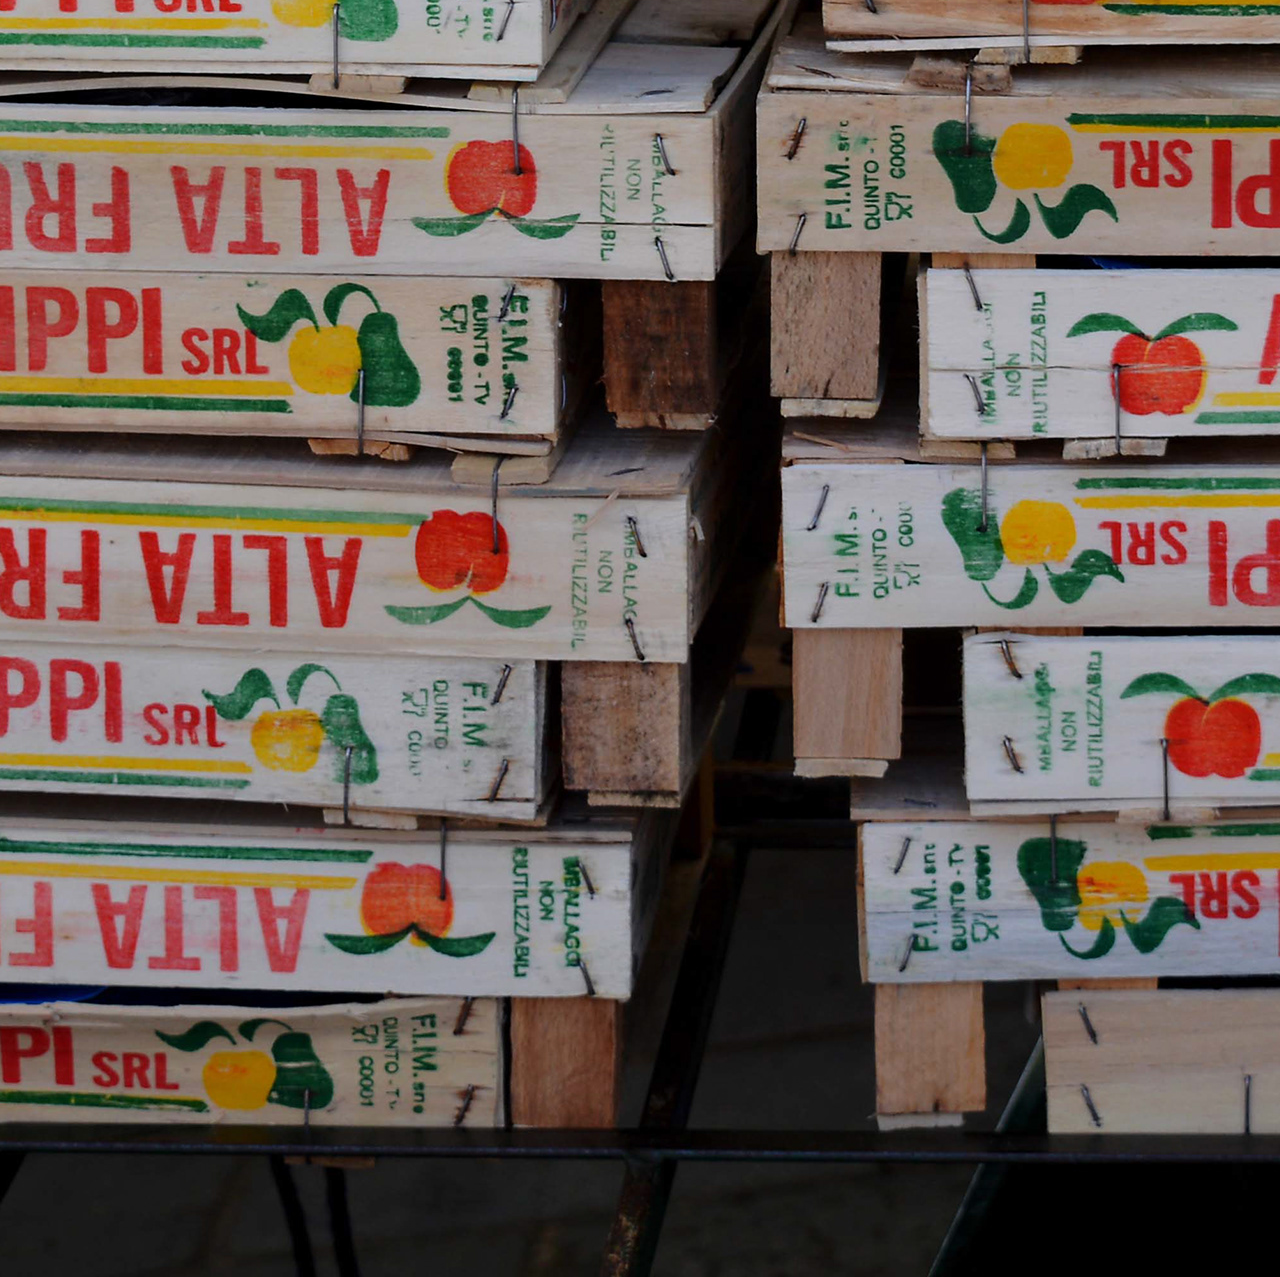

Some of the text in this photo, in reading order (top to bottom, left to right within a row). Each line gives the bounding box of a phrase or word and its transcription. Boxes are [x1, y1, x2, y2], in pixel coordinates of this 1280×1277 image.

[1100, 139, 1193, 189] SRL
[170, 166, 391, 256] ALTA
[863, 159, 881, 231] QUINTO
[181, 328, 270, 375] SRL
[471, 293, 490, 368] QUINTO
[1004, 353, 1021, 398] NON
[1099, 521, 1188, 566] SRL
[139, 531, 363, 628] ALTA
[143, 703, 225, 748] SRL
[1061, 710, 1078, 752] NON
[540, 879, 556, 922] NON
[1170, 870, 1261, 919] SRL
[91, 883, 310, 973] ALTA
[383, 1015, 400, 1074] QUINTO
[91, 1052, 180, 1091] SRL
